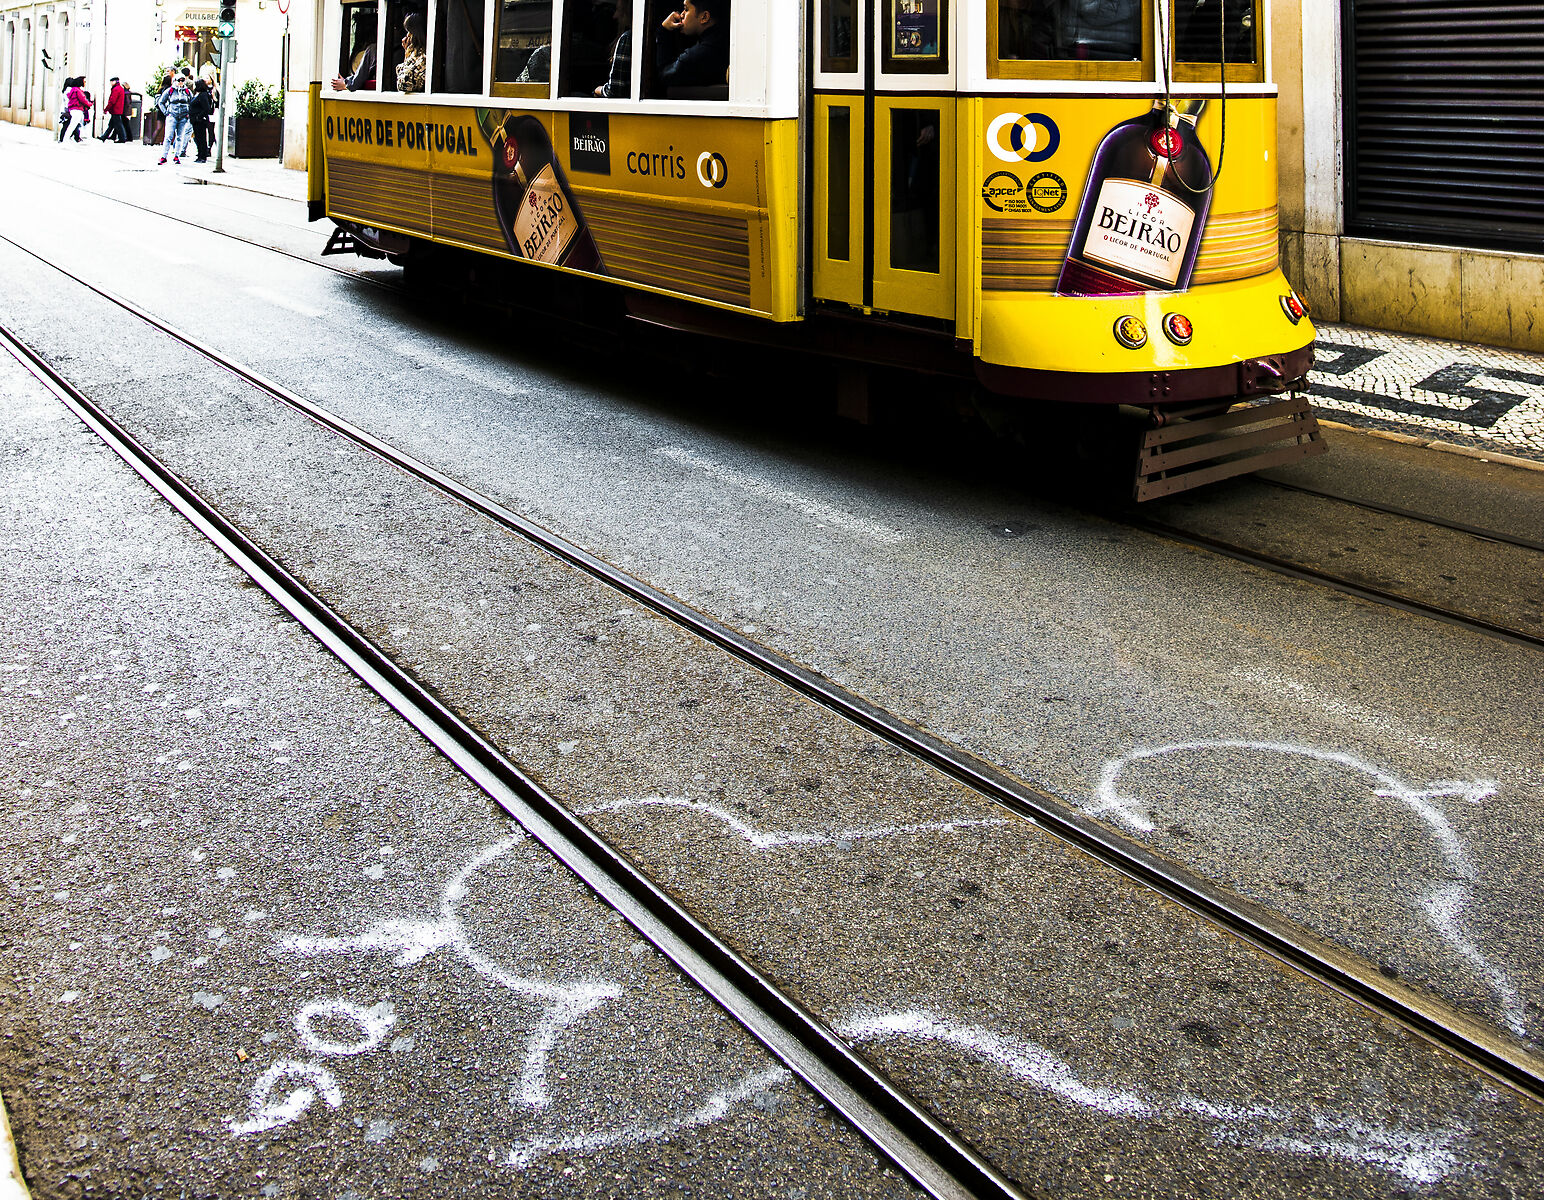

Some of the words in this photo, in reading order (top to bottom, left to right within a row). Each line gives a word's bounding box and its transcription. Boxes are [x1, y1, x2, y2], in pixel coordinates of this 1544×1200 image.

[185, 12, 219, 21] PULL&BEA
[326, 115, 334, 141] O
[337, 116, 373, 145] LICOR
[376, 119, 393, 147] DE
[397, 120, 478, 157] PORTUGAL
[573, 136, 606, 154] BEIRÃO
[626, 144, 686, 180] carris
[989, 187, 1017, 198] apcer
[1034, 188, 1060, 198] IQNet
[523, 192, 563, 259] BEIRÃO
[1128, 208, 1165, 226] LICOR
[1098, 206, 1182, 253] BEIRÃO
[1109, 236, 1128, 247] LICOR
[1130, 243, 1138, 251] DE
[1140, 247, 1170, 262] PORTUGAL
